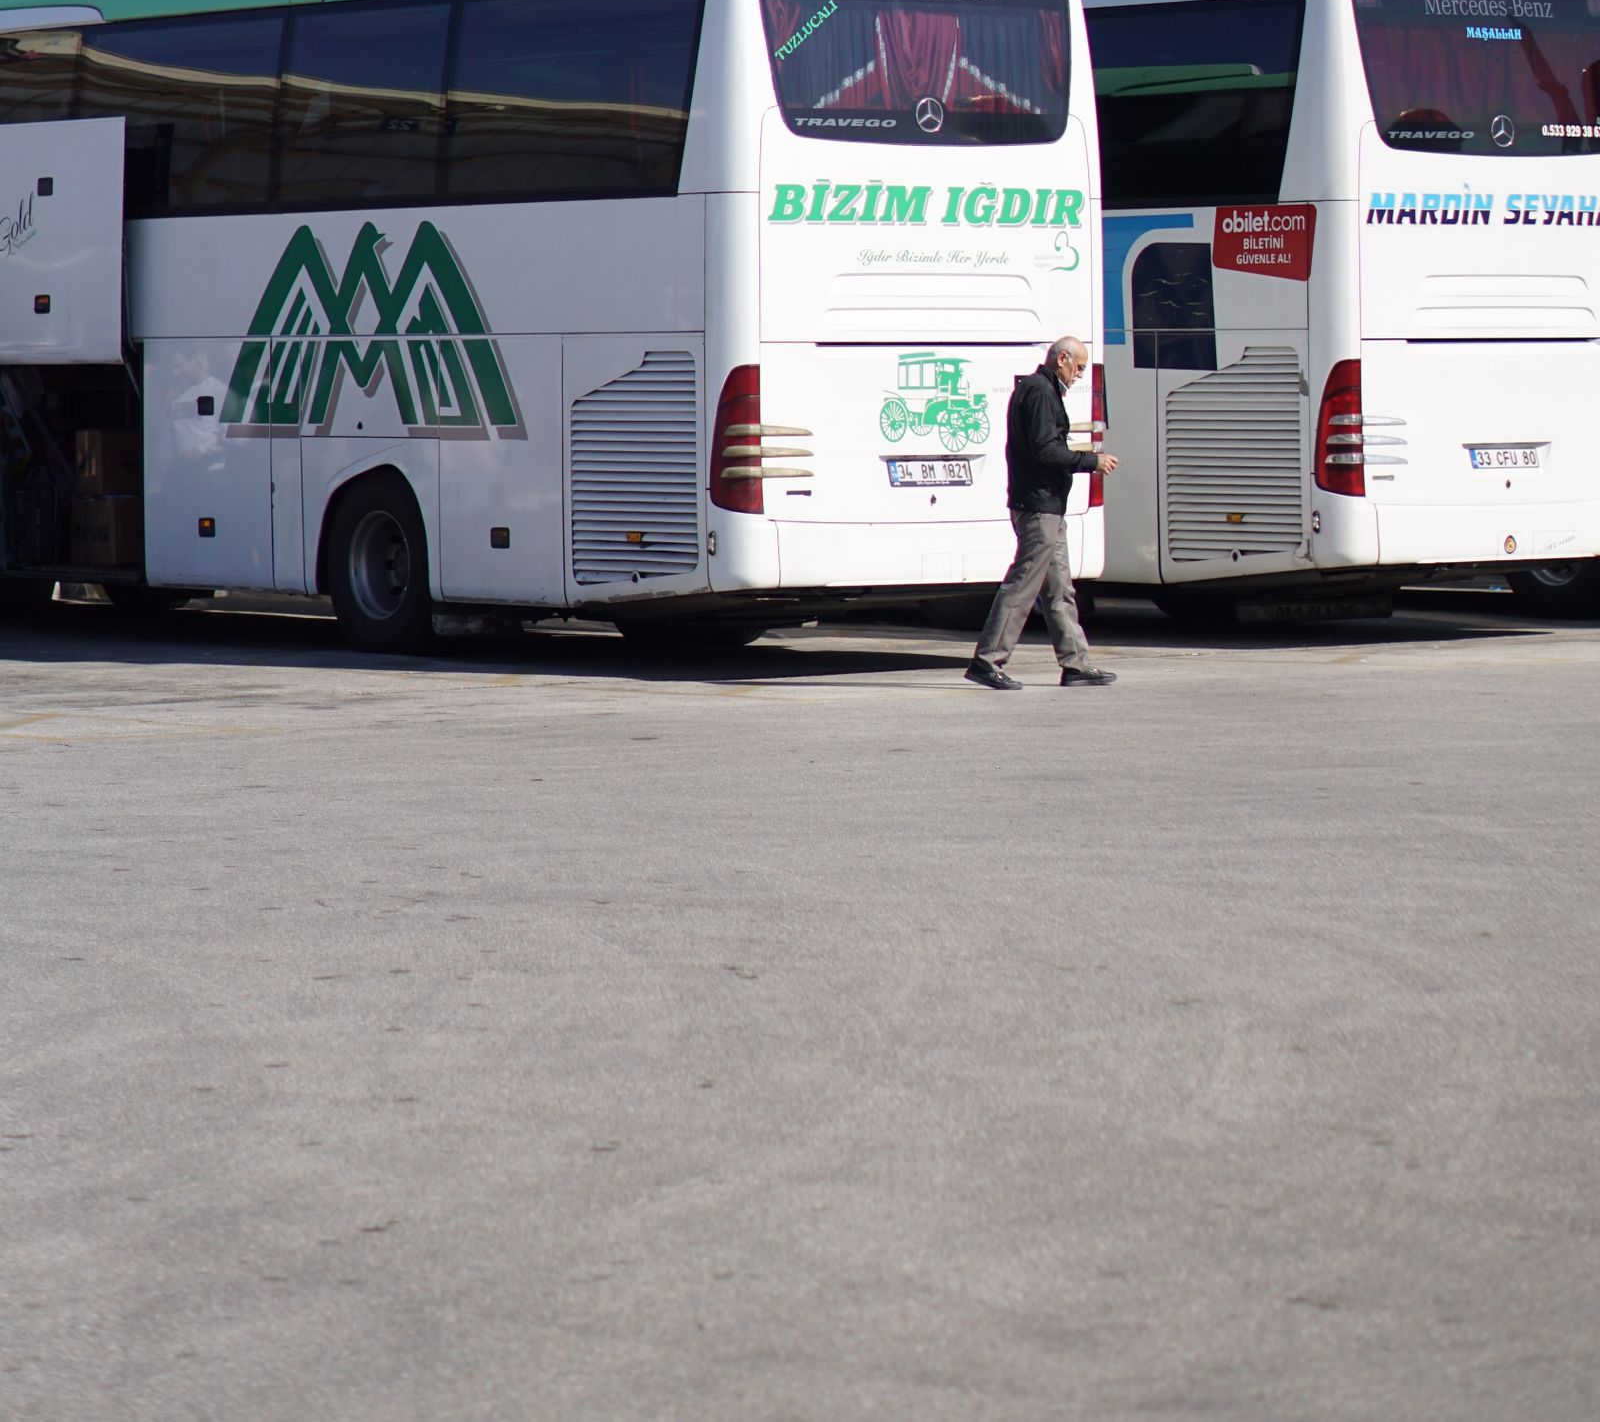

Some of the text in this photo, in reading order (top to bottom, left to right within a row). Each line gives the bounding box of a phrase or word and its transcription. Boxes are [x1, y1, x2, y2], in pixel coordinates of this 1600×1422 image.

[1466, 26, 1522, 41] MAŞALLAH
[795, 117, 897, 129] TRAVEGO
[1541, 124, 1565, 136] 0.533
[1566, 125, 1581, 137] 929
[1582, 125, 1593, 137] 38
[1388, 130, 1475, 139] TRAVEGO
[767, 178, 1086, 228] BİZİM IĞDIR
[1366, 182, 1494, 225] MARDİN
[1222, 209, 1306, 233] obilet.com
[1243, 234, 1284, 250] BİLETİNİ
[896, 249, 943, 264] Bizimle
[946, 249, 972, 264] Her
[973, 250, 1009, 268] Yerde
[1236, 251, 1292, 265] GÜVENLE AL!
[1477, 450, 1537, 466] 33 CFU 80
[898, 463, 969, 479] 34 BM 1821
